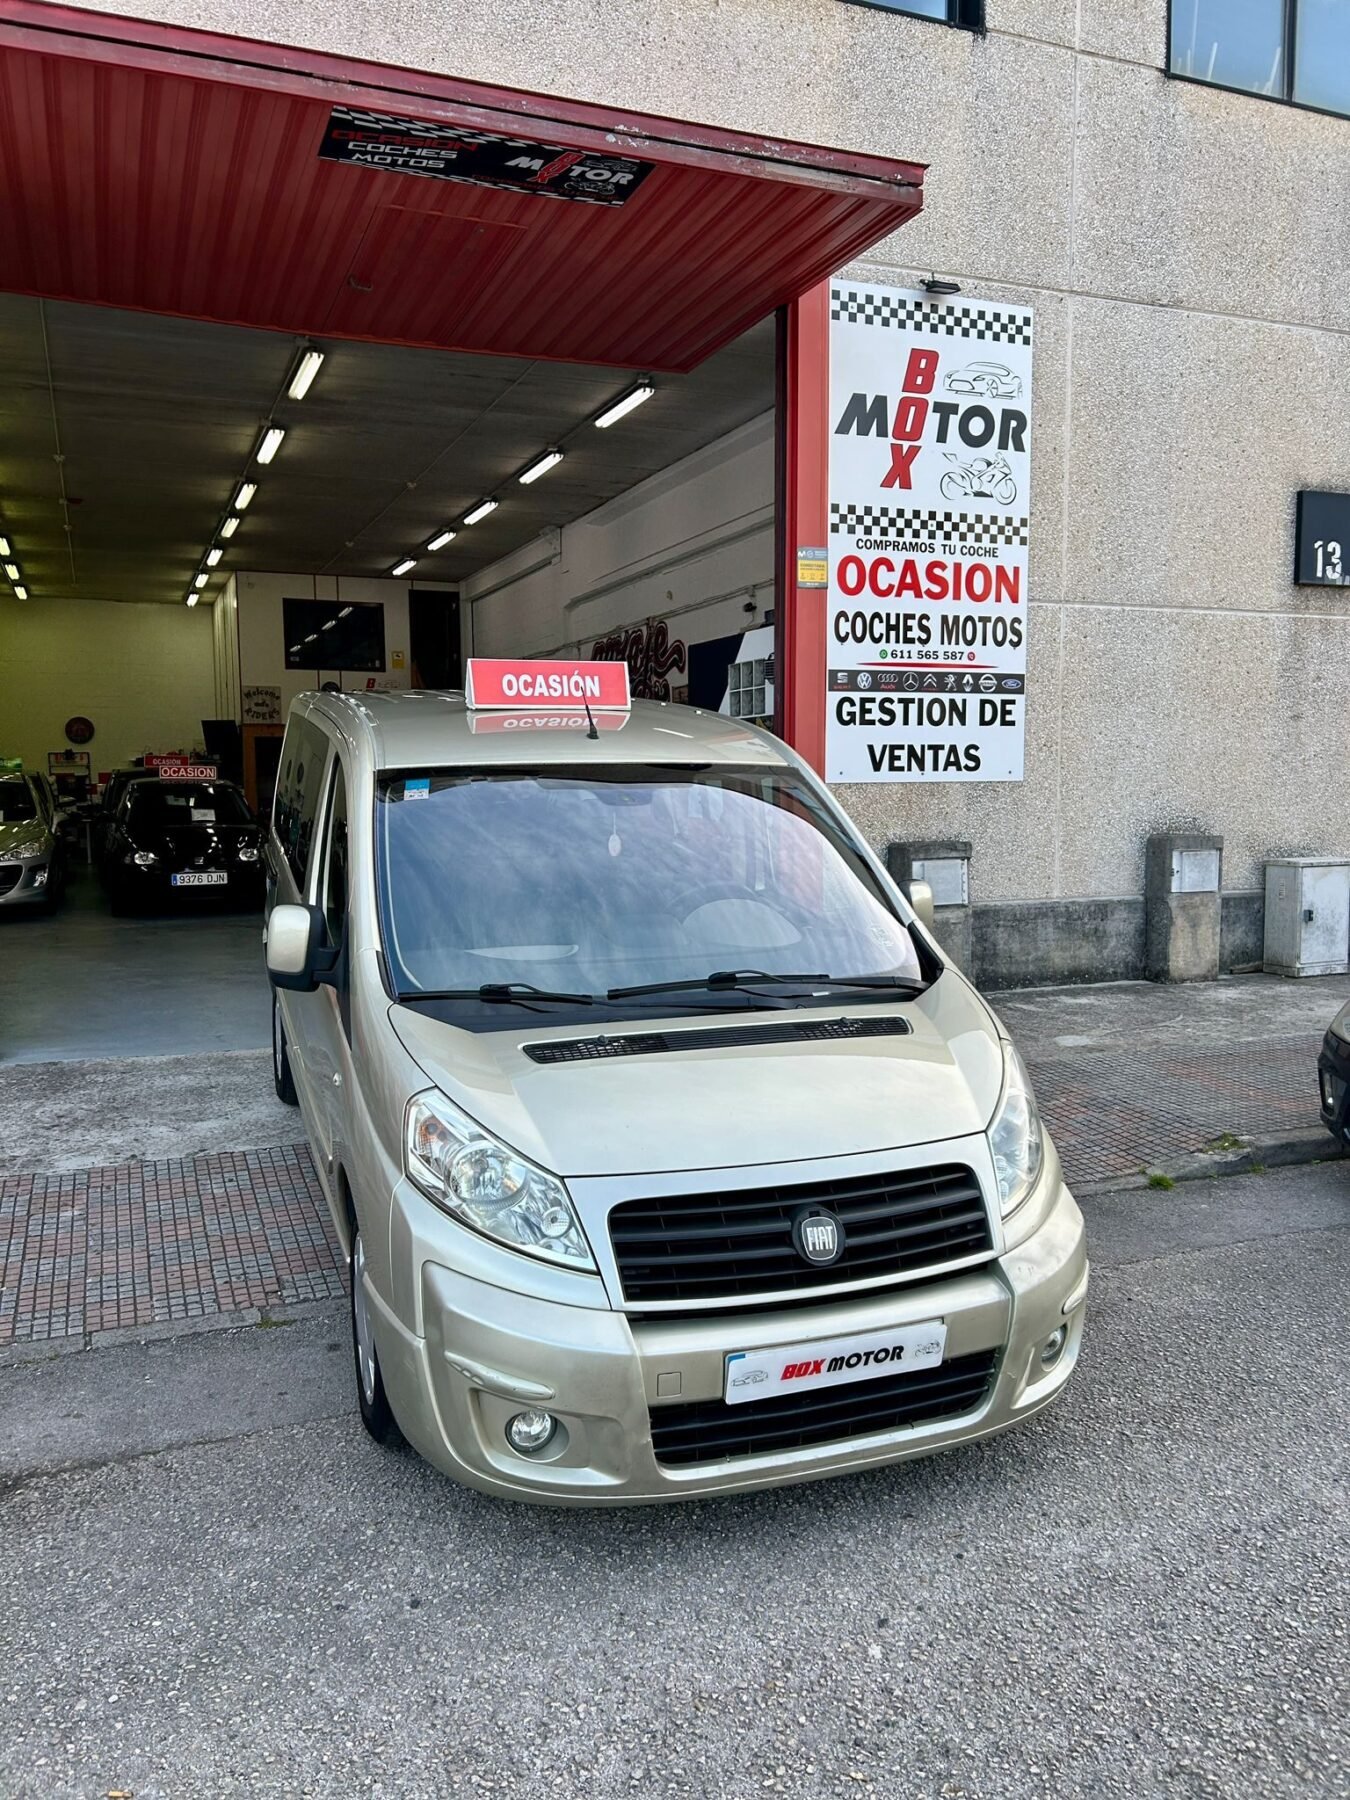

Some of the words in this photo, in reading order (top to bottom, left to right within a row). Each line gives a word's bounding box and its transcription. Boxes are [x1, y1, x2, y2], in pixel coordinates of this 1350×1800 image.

[331, 129, 479, 152] OCASION
[348, 141, 458, 159] COCHES
[351, 153, 446, 168] MOTOS
[834, 393, 1028, 453] MOTOR
[880, 348, 940, 490] BOX
[856, 538, 935, 554] COMPRAMOS
[941, 544, 957, 556] TU
[961, 545, 999, 558] COCHE
[836, 554, 1021, 605] OCASION
[834, 610, 932, 646] COCHES
[940, 614, 1023, 649] MOTOS
[890, 650, 912, 660] 611
[917, 650, 939, 660] 565
[943, 651, 965, 661] 587
[502, 670, 600, 698] OCASIÓN
[836, 696, 967, 727] GESTION
[979, 698, 1017, 727] DE
[867, 744, 981, 773] VENTAS
[161, 767, 215, 778] OCASION
[179, 875, 204, 884] 9376
[207, 874, 225, 883] DJN
[806, 1226, 833, 1251] FIAT
[780, 1358, 826, 1381] BOX
[826, 1345, 904, 1373] MOTOR
